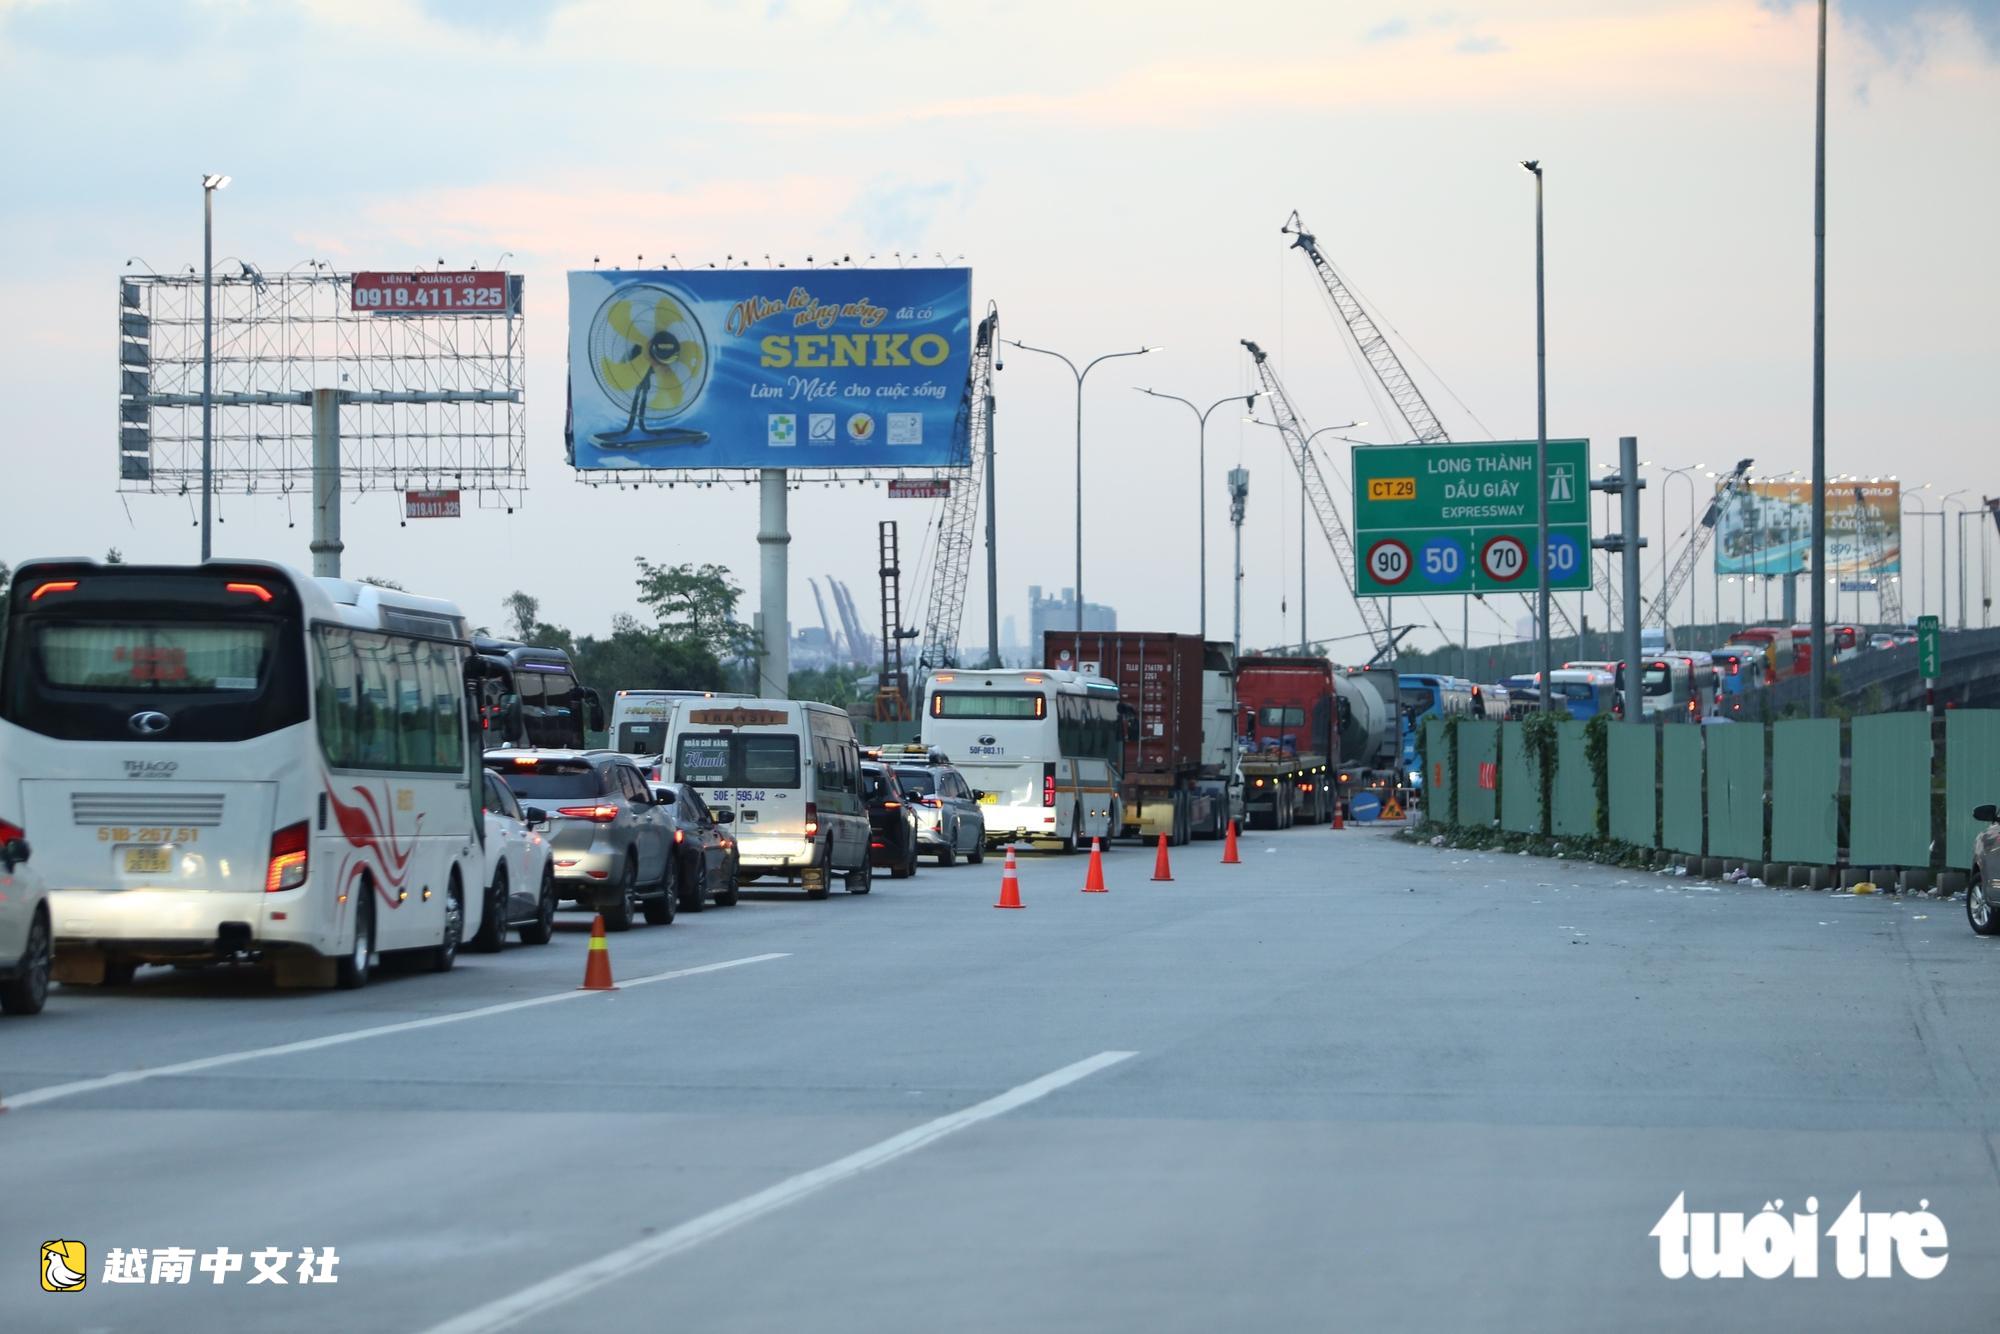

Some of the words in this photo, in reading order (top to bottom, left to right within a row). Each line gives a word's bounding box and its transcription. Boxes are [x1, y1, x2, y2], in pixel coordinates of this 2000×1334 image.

[404, 275, 416, 285] H
[455, 272, 476, 284] CÁO
[355, 287, 502, 307] 0919.411.325
[724, 295, 783, 337] Mùa
[896, 306, 914, 320] đã
[916, 306, 933, 320] có
[760, 333, 950, 368] SENKO
[750, 383, 783, 398] Làm
[787, 375, 838, 401] Mát
[844, 383, 871, 397] cho
[876, 382, 909, 399] cuộc
[912, 379, 947, 399] sống
[1427, 457, 1471, 474] LONG
[1475, 453, 1533, 473] THÀNH
[1372, 481, 1414, 496] CT.29
[1483, 480, 1520, 498] GIÂY
[1441, 504, 1525, 519] EXPRESSWAY
[1378, 552, 1401, 573] 90
[1426, 547, 1458, 574] 50
[1493, 548, 1517, 569] 70
[1919, 620, 1937, 630] KM
[123, 760, 179, 771] THACO
[713, 790, 729, 801] 50E
[736, 790, 766, 802] 595.42
